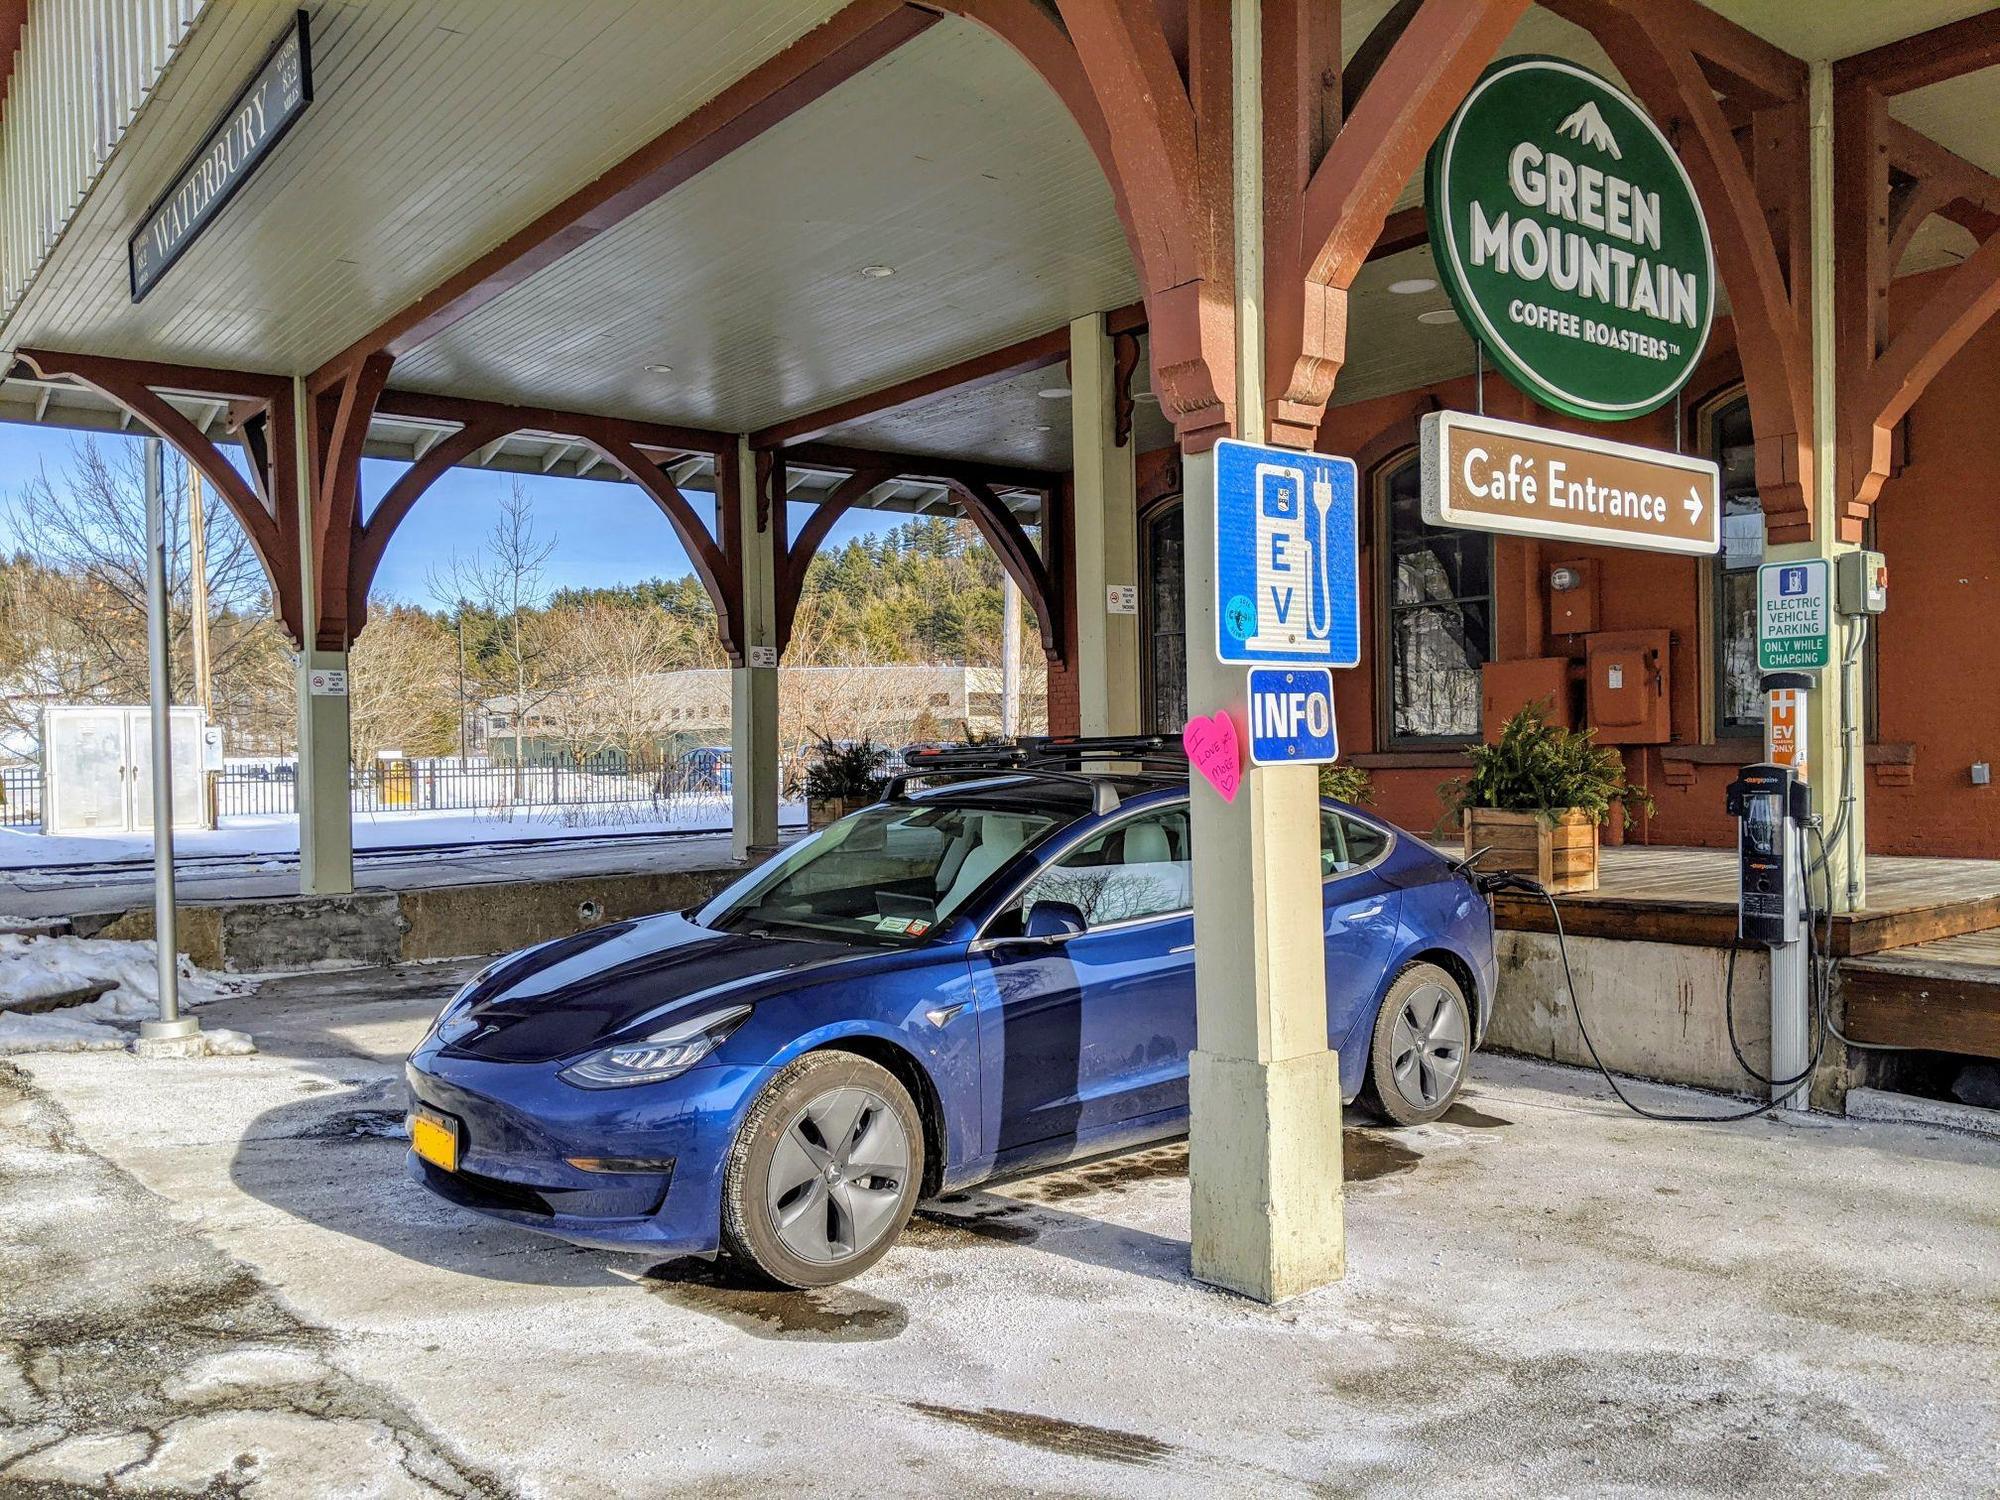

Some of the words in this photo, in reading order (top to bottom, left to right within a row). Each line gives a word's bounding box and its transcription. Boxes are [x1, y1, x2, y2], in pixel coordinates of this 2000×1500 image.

[153, 80, 268, 257] WATERBURY
[1508, 142, 1660, 251] GREEN
[1470, 200, 1697, 329] MOUNTAIN
[1509, 299, 1581, 339] COFFEE
[1463, 448, 1538, 504] Café
[1549, 460, 1667, 522] Entrance
[1767, 597, 1821, 610] ELECTRIC
[1770, 610, 1818, 623] VEHICLE
[1769, 623, 1819, 636] PARKING
[1764, 641, 1790, 652] ONLY
[1793, 639, 1823, 650] WHILE
[1769, 653, 1818, 665] CHARGING
[1254, 692, 1329, 739] INFO
[1773, 725, 1794, 739] EV
[1198, 741, 1221, 765] LOVE
